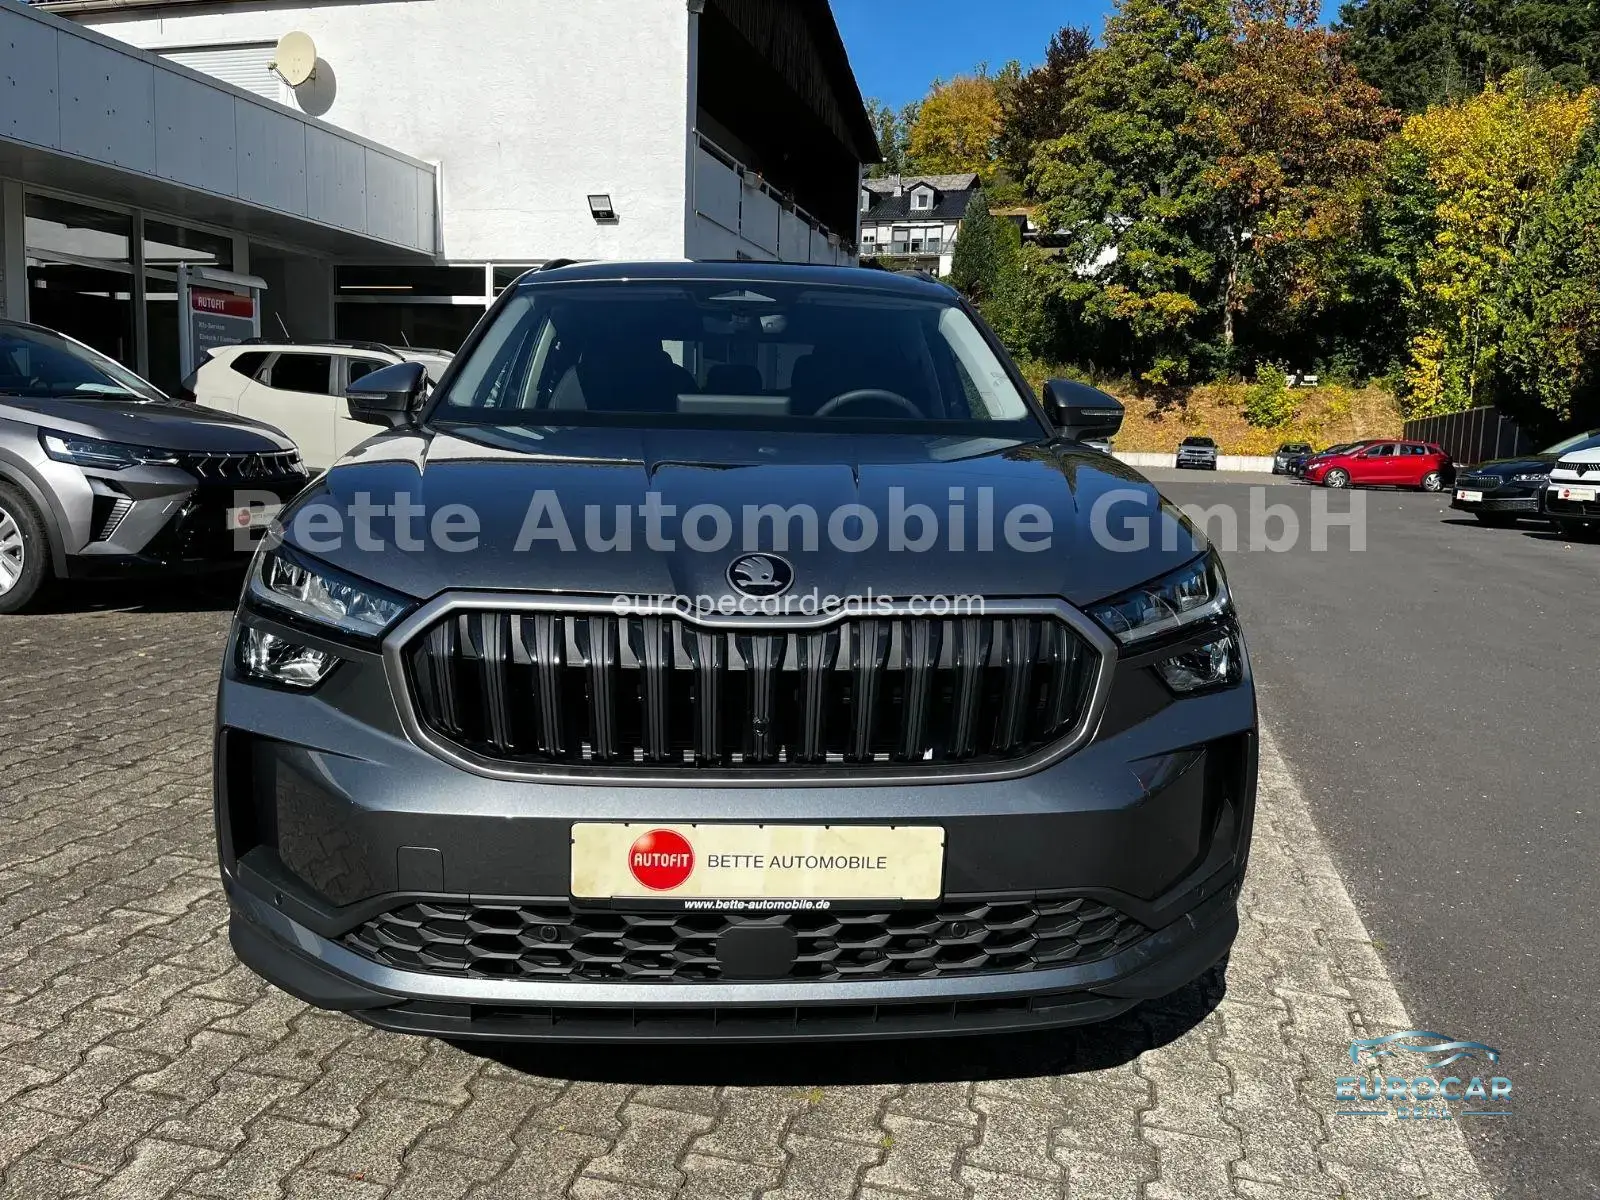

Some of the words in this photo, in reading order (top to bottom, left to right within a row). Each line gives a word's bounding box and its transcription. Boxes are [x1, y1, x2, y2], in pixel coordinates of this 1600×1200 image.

[198, 296, 225, 310] AUTOFIT
[633, 852, 690, 868] AUTOFIT
[707, 854, 764, 869] BETTE
[769, 855, 887, 870] AUTOMOBILE
[684, 899, 831, 910] www.bette-automobile.de
